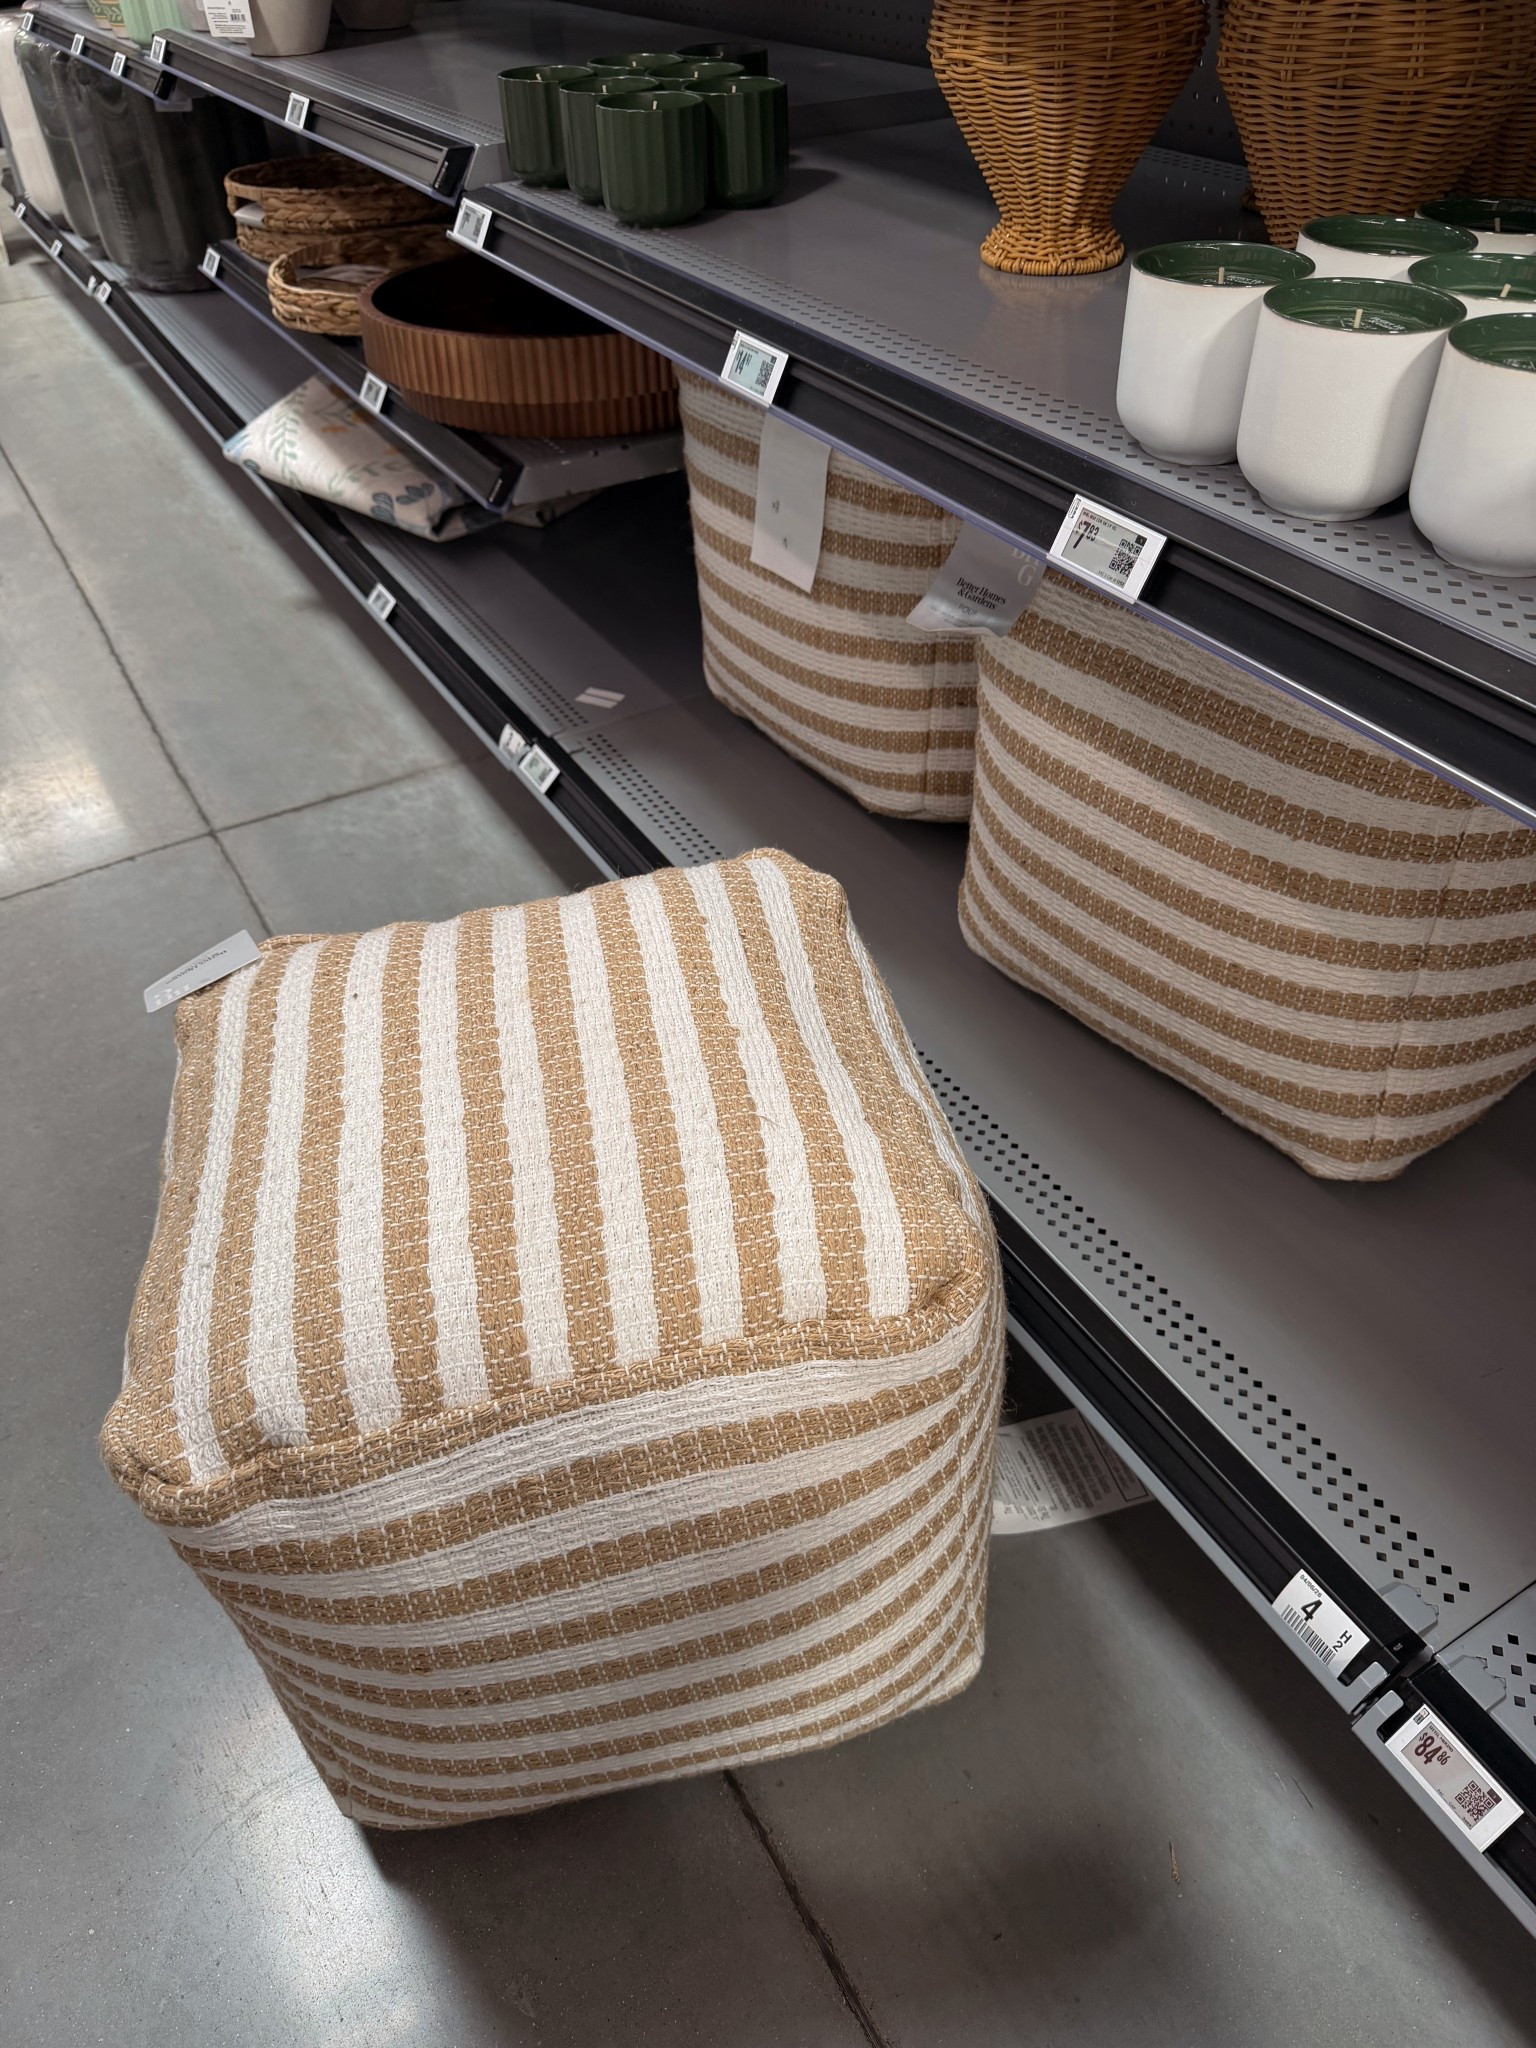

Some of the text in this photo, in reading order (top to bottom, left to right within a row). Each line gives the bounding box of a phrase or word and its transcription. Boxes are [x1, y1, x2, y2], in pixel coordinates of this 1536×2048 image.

[956, 577, 1007, 605] Better Homes
[963, 589, 998, 610] Gardens
[1300, 1599, 1353, 1645] 4 H
[1332, 1640, 1344, 1653] 2
